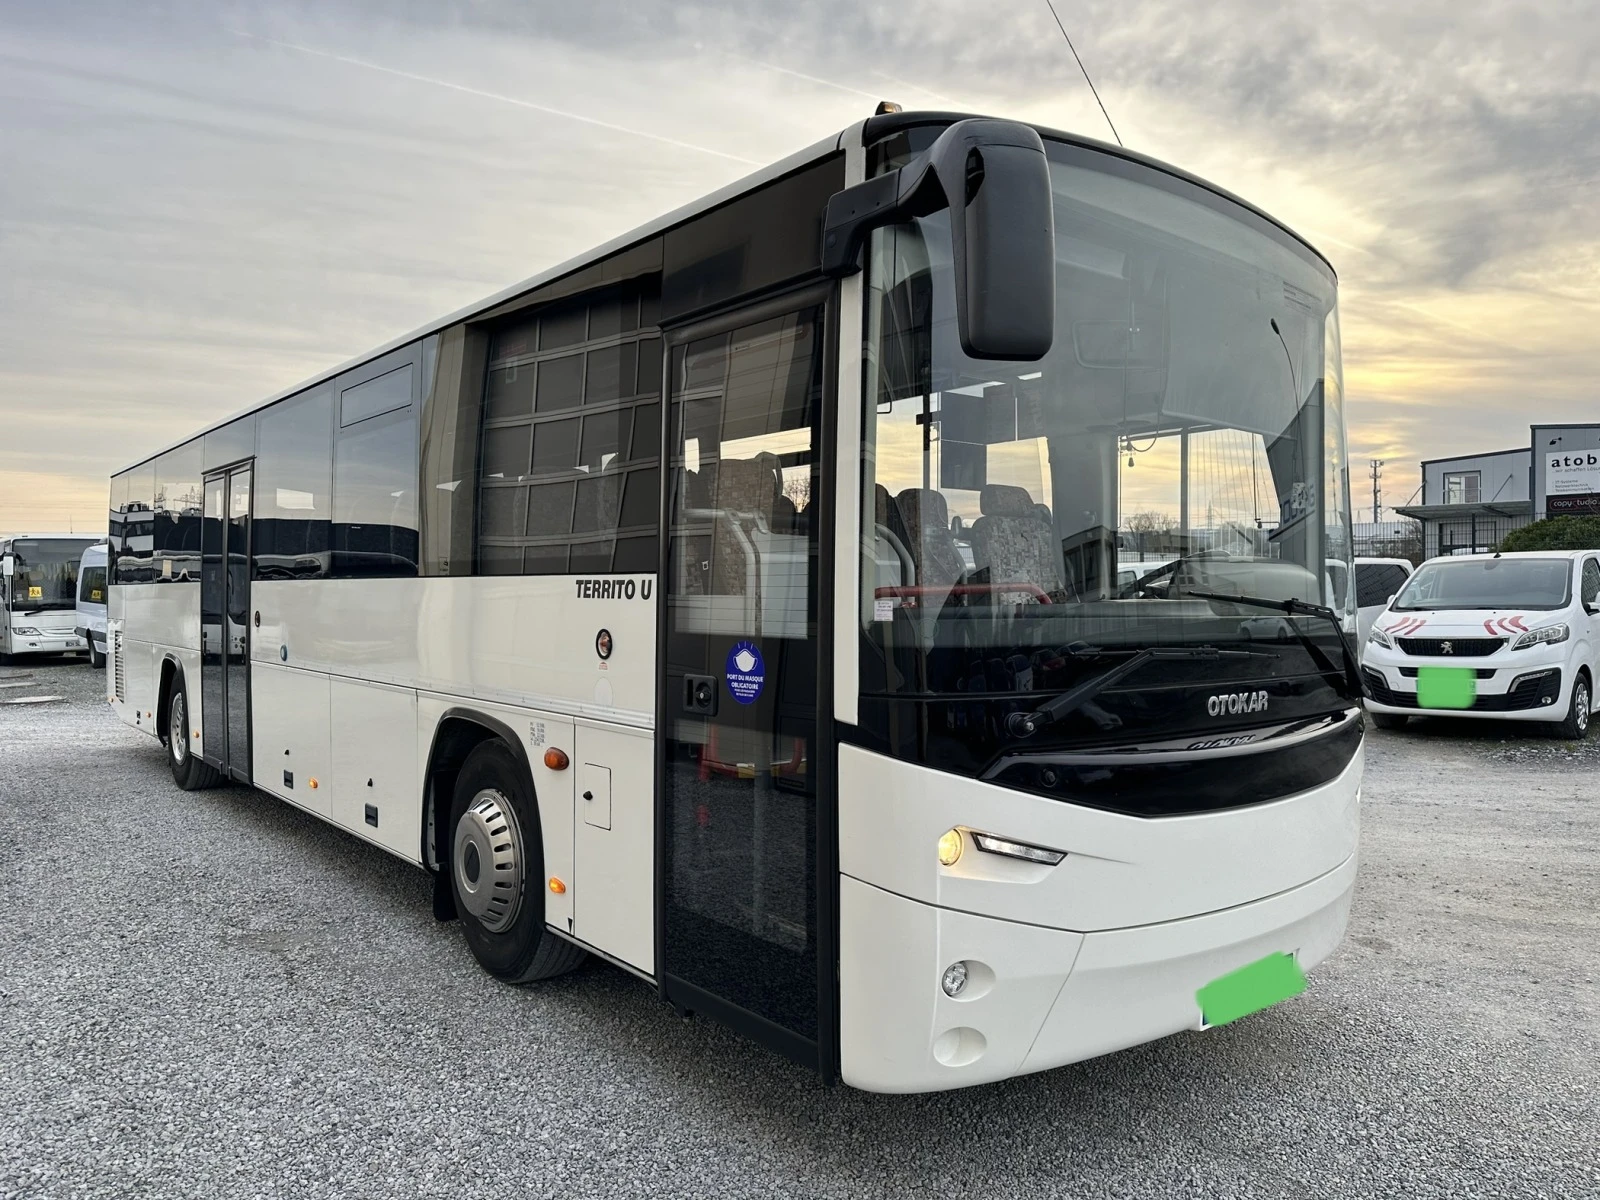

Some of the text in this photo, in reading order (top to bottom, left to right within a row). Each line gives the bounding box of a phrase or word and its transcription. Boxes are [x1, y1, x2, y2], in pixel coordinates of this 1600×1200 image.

[575, 579, 652, 600] TERRITO U
[731, 681, 758, 689] OBLIGATOIRE
[1207, 690, 1269, 717] OTOKAR
